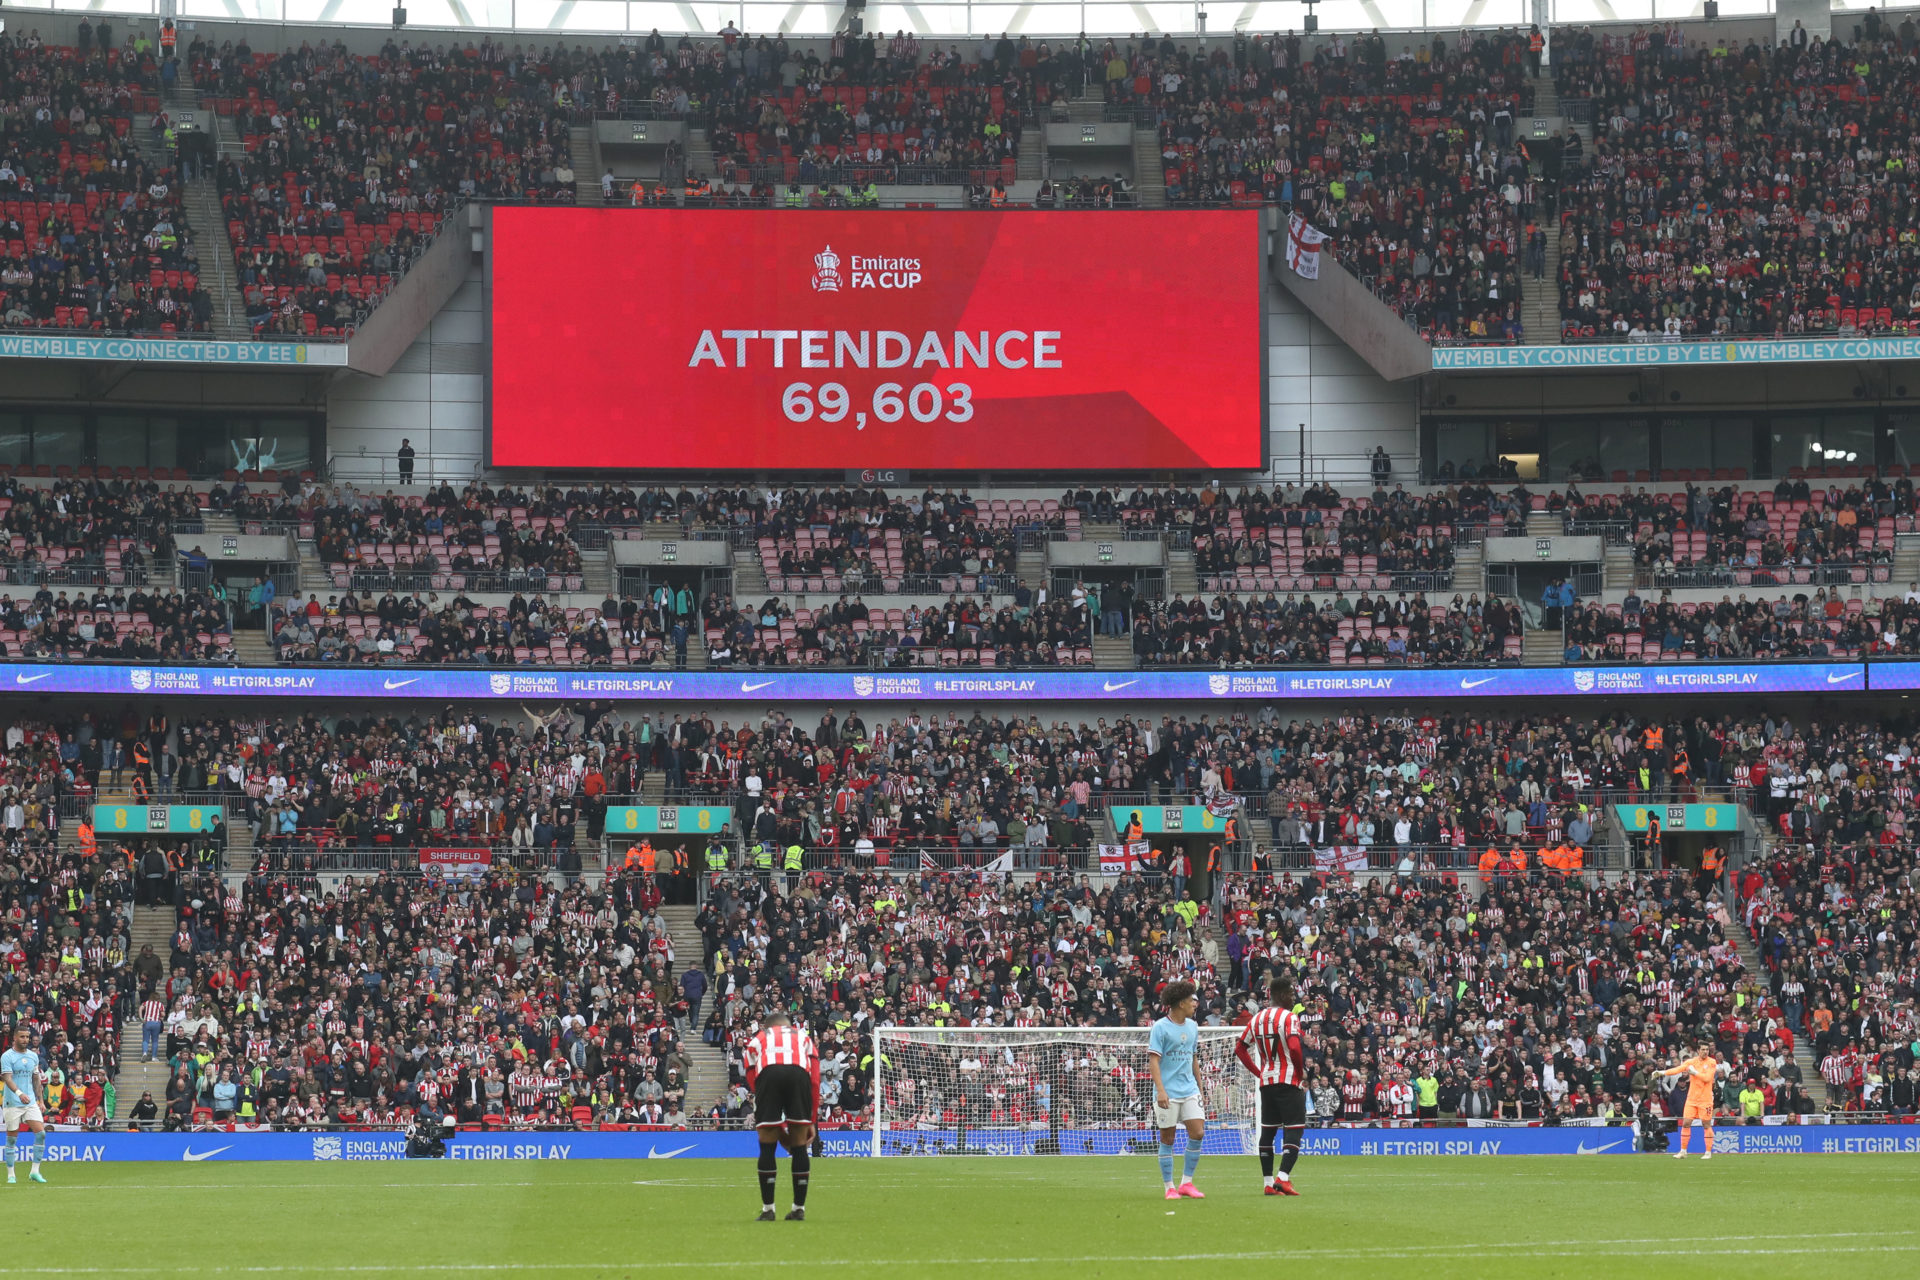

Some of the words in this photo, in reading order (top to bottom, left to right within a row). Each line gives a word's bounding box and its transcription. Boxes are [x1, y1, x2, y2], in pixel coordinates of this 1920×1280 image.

[851, 255, 920, 271] Emirates
[851, 273, 876, 288] FA
[879, 272, 921, 288] CUP
[2, 338, 101, 356] WEMBLEY
[107, 342, 229, 360] CONNECTED
[237, 344, 265, 361] BY
[269, 346, 290, 361] EE
[688, 330, 1062, 369] ATTENDANCE
[1435, 349, 1532, 365] WEMBLEY
[1537, 346, 1660, 364] CONNECTED
[1667, 345, 1694, 361] BY
[1699, 345, 1721, 360] EE
[1738, 343, 1838, 359] WEMBLEY
[782, 382, 974, 430] 69,603
[878, 471, 895, 482] LG
[155, 673, 198, 681] ENGLAND
[514, 677, 555, 685] ENGLAND
[1233, 676, 1276, 684] ENGLAND
[1598, 672, 1640, 680] ENGLAND
[155, 681, 200, 689] FOOTBALL
[514, 685, 559, 693] FOOTBALL
[877, 685, 922, 693] FOOTBALL
[1233, 684, 1278, 692] FOOTBALL
[1598, 680, 1643, 688] FOOTBALL
[430, 851, 481, 861] SHEFFIELD
[822, 1140, 871, 1152] ENGLAN
[1744, 1135, 1802, 1147] ENGLAND
[346, 1141, 406, 1153] ENGLAND
